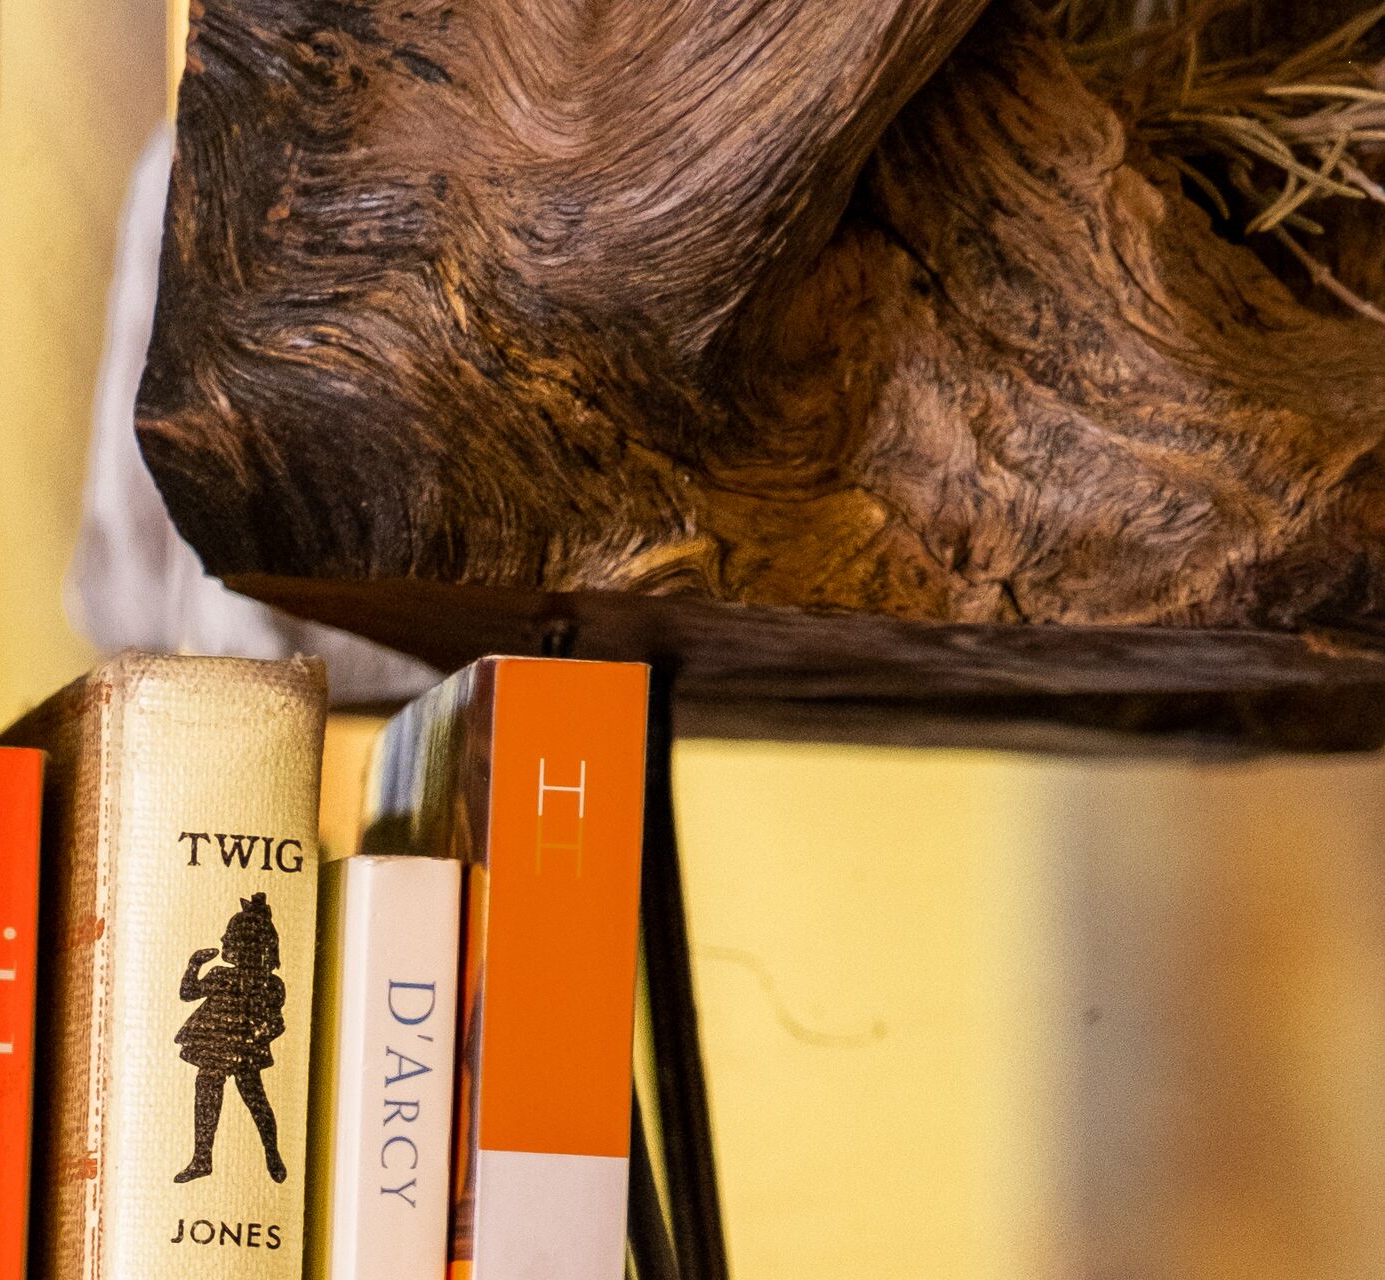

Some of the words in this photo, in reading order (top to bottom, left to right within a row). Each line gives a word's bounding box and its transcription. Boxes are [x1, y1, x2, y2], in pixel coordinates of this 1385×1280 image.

[538, 758, 586, 818] H
[179, 832, 303, 873] TWIG
[171, 1220, 281, 1250] JONES
